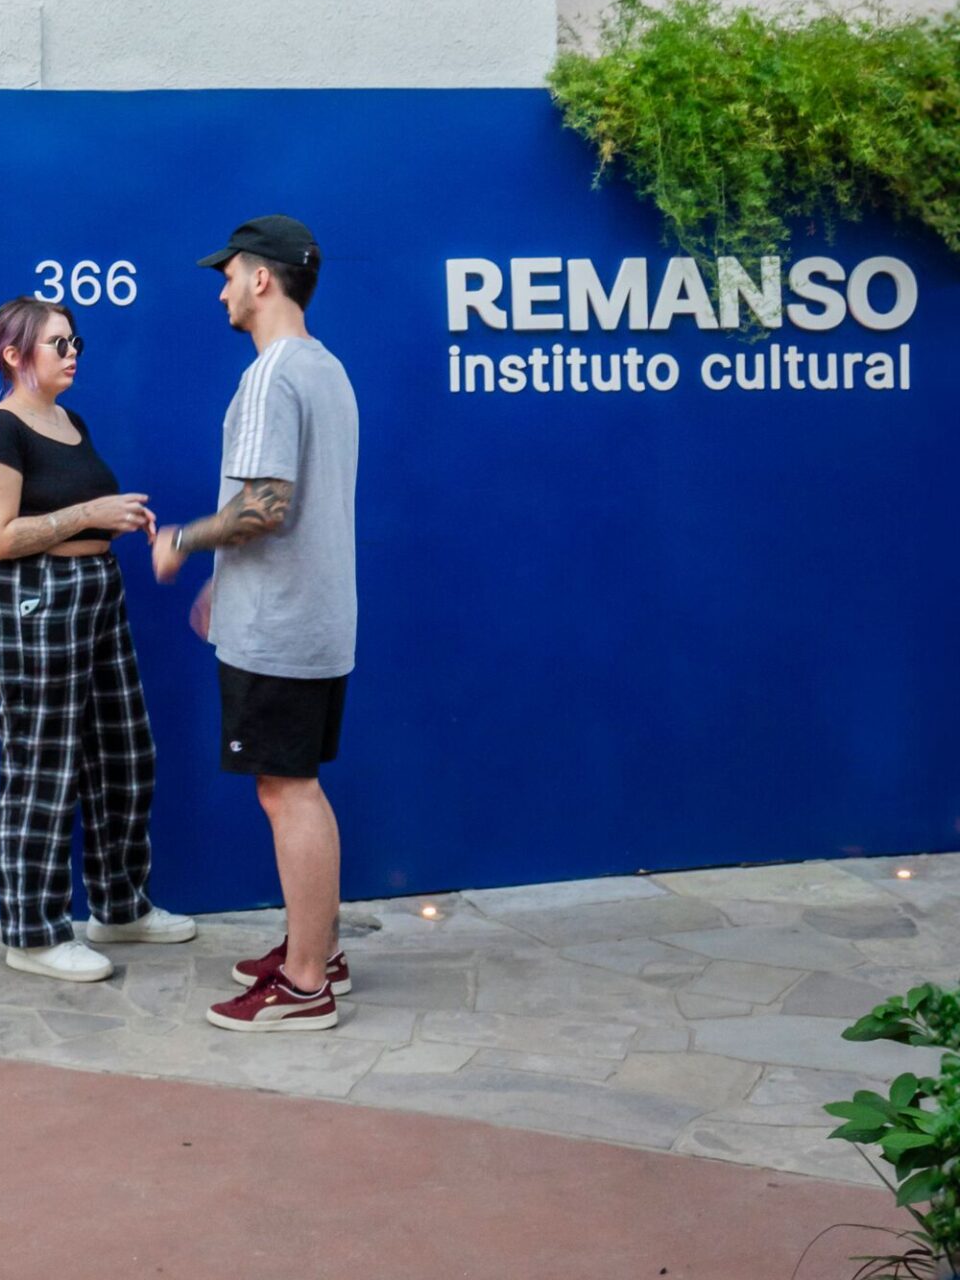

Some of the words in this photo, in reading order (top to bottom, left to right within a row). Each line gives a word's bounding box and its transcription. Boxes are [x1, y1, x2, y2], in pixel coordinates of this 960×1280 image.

[34, 260, 138, 306] 366
[446, 255, 919, 331] REMANSO
[448, 343, 680, 393] instituto
[701, 343, 911, 391] cultural
